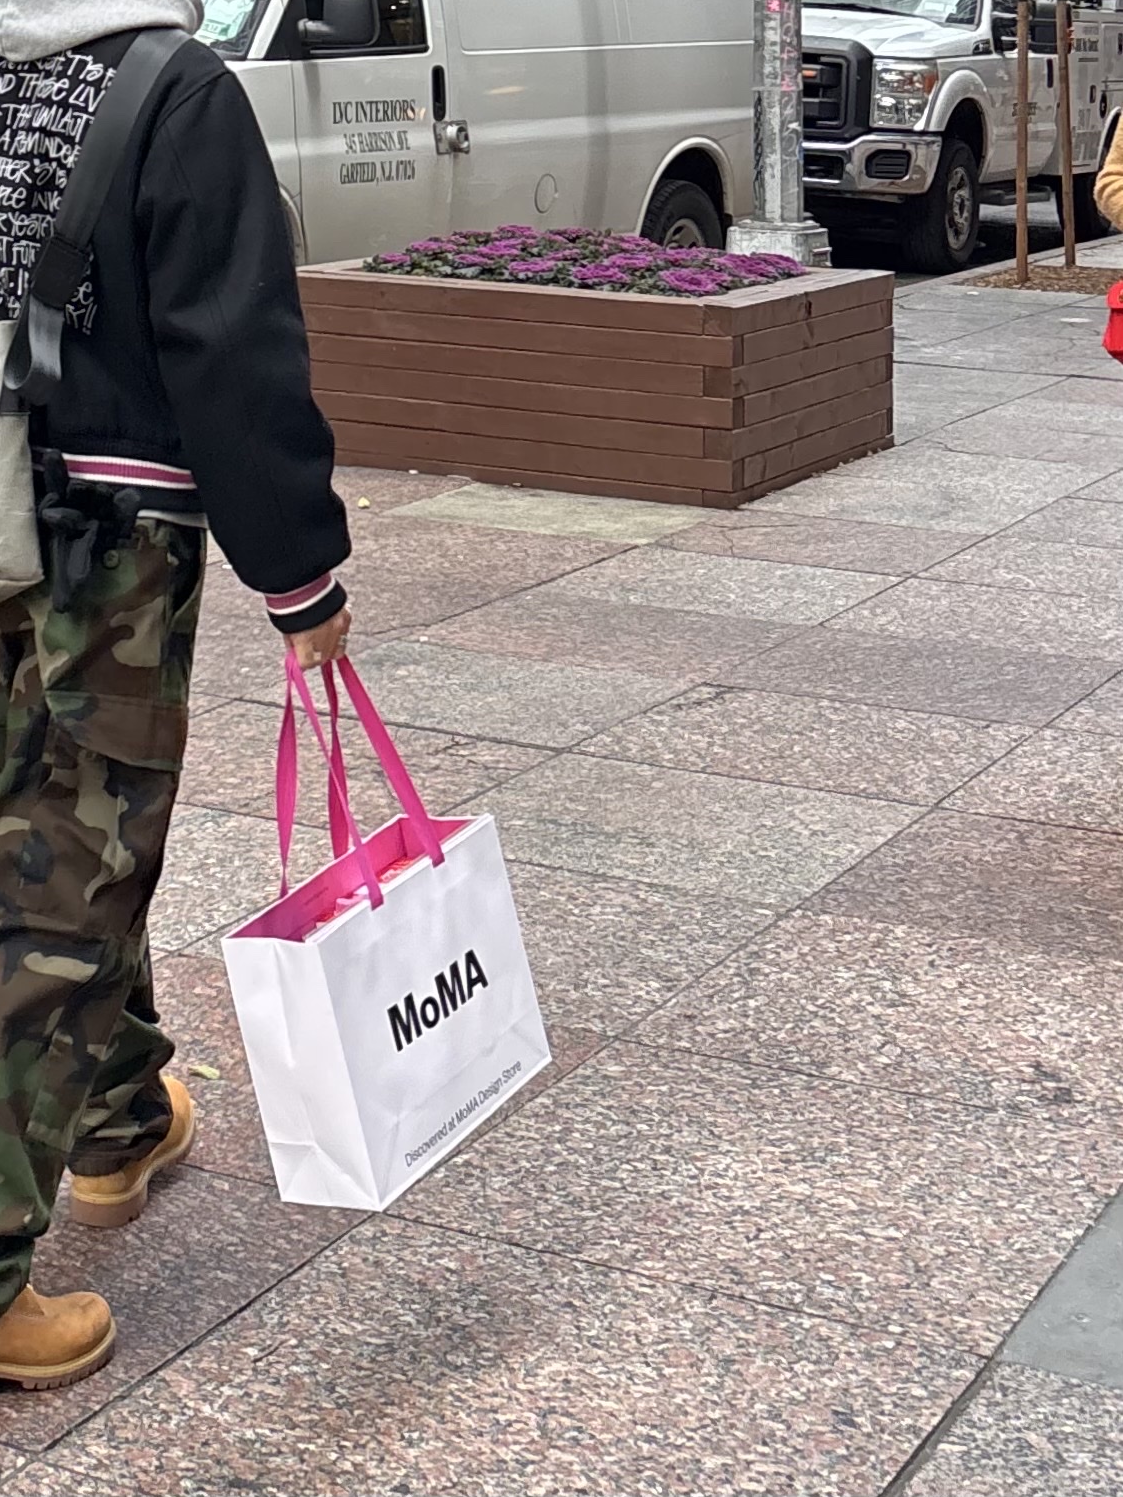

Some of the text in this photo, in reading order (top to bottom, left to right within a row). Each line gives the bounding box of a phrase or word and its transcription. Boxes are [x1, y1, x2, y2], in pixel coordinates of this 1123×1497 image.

[354, 98, 417, 124] INTERIORS
[339, 161, 380, 186] GARFIELD,
[386, 948, 489, 1053] MoMA
[404, 1060, 522, 1168] Discovered at MoMA Design Store
